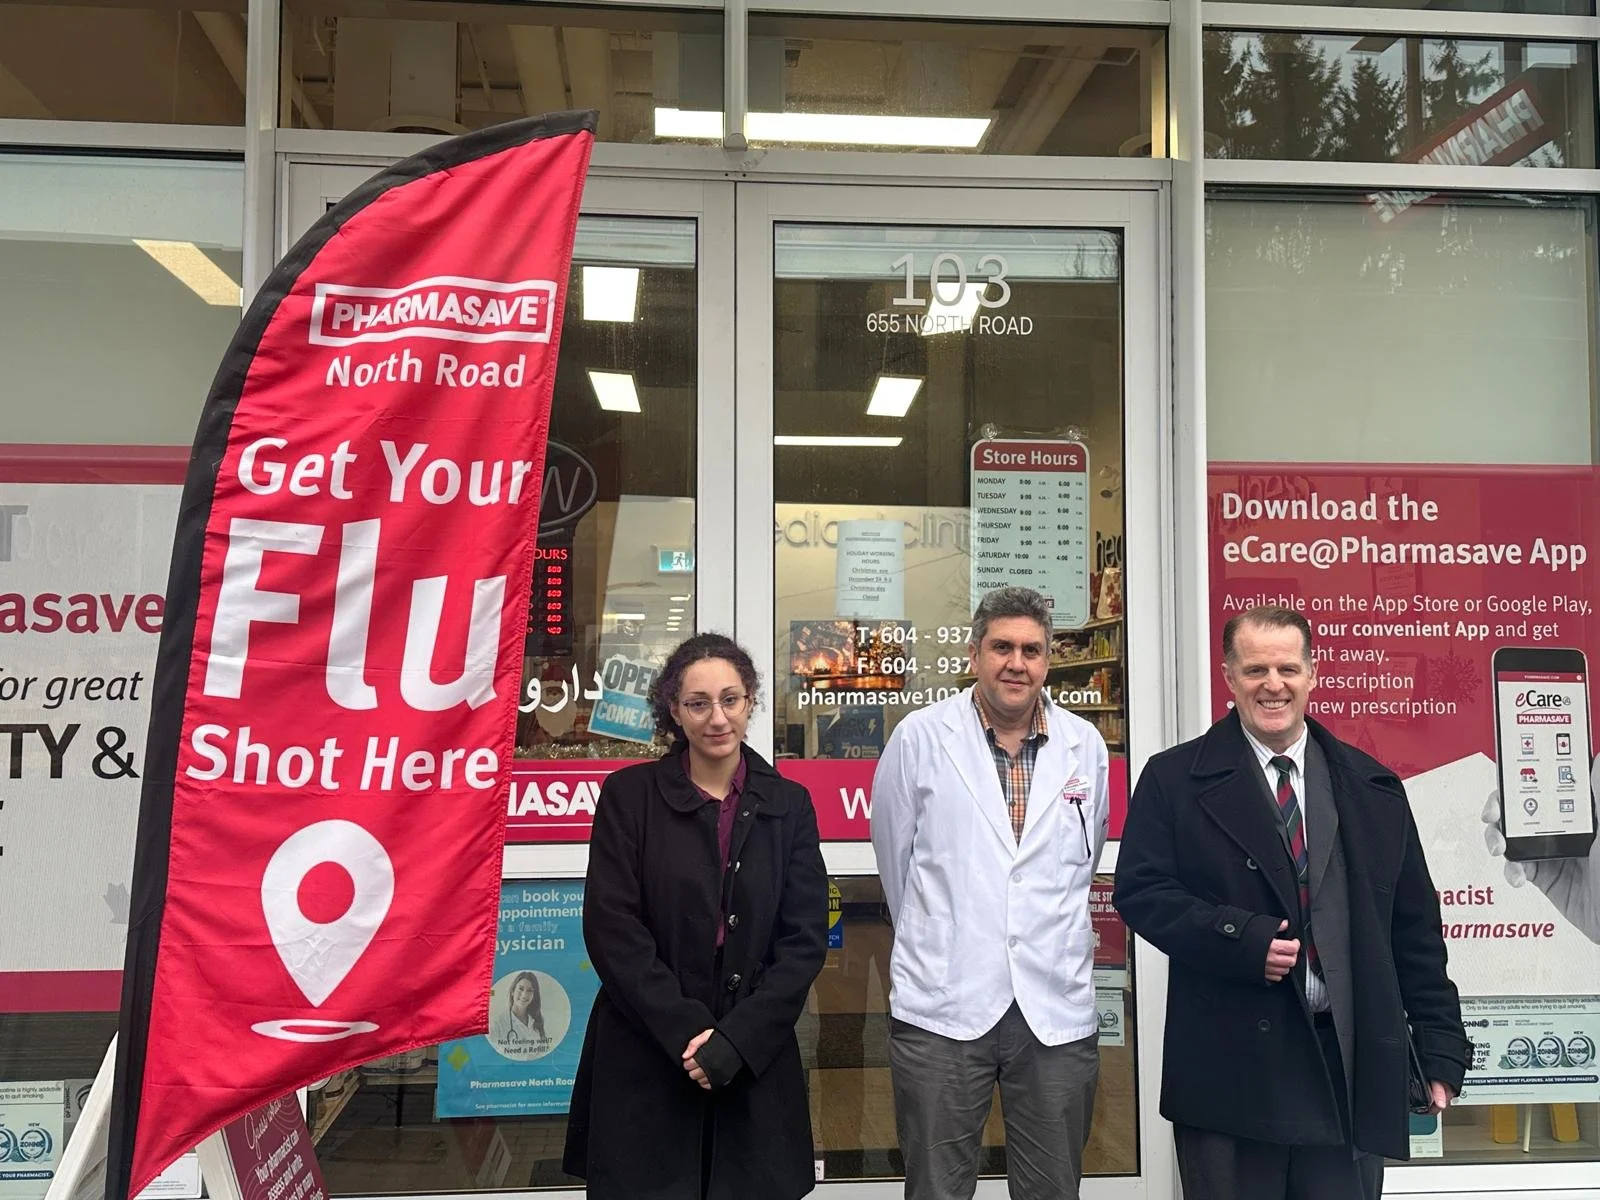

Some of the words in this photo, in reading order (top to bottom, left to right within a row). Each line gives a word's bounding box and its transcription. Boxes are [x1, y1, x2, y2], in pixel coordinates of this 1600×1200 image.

[889, 252, 1012, 309] 103
[866, 313, 900, 333] 655
[905, 314, 974, 335] NORTH
[979, 315, 1033, 335] ROAD
[325, 348, 423, 388] North
[435, 353, 526, 388] Road
[983, 449, 1026, 465] Store
[1031, 450, 1078, 466] Hours
[237, 437, 358, 500] Get
[380, 440, 532, 506] Your
[977, 477, 1006, 485] MONDAY
[1223, 493, 1378, 521] Download
[1388, 493, 1439, 521] the
[977, 551, 1010, 559] SATURDAY
[1222, 535, 1522, 569] eCare@Pharmasave
[1529, 538, 1588, 571] App
[0, 592, 164, 635] asave
[203, 517, 507, 712] Flu
[1223, 593, 1306, 611] Available
[1311, 598, 1334, 612] on
[1339, 594, 1368, 612] the
[1372, 595, 1409, 616] App
[1413, 594, 1459, 612] Store
[1464, 599, 1481, 612] or
[1487, 595, 1548, 616] Google
[1553, 595, 1593, 616] Play,
[856, 626, 874, 644] T:
[881, 626, 918, 644] 604
[937, 626, 973, 644] 937
[1318, 623, 1347, 637] our
[1352, 620, 1452, 637] convenient
[1455, 621, 1489, 641] App
[1495, 621, 1527, 637] and
[1533, 623, 1559, 641] get
[857, 656, 874, 674] F:
[881, 656, 918, 674] 604
[937, 656, 971, 674] 937
[1339, 648, 1390, 666] away.
[0, 668, 38, 702] or
[41, 670, 144, 710] great
[1315, 672, 1414, 693] rescription
[596, 700, 640, 727] COME
[1309, 701, 1345, 714] new
[1351, 698, 1457, 719] prescription
[1518, 714, 1570, 723] PHARMASAVE
[91, 725, 140, 780] &
[185, 723, 344, 790] Shot
[359, 736, 498, 791] Here
[842, 745, 861, 758] 70
[522, 888, 560, 903] book
[562, 893, 584, 905] you
[497, 905, 583, 922] ppointment
[519, 921, 559, 934] family
[470, 1080, 527, 1089] Pharmasave
[528, 1078, 554, 1087] North
